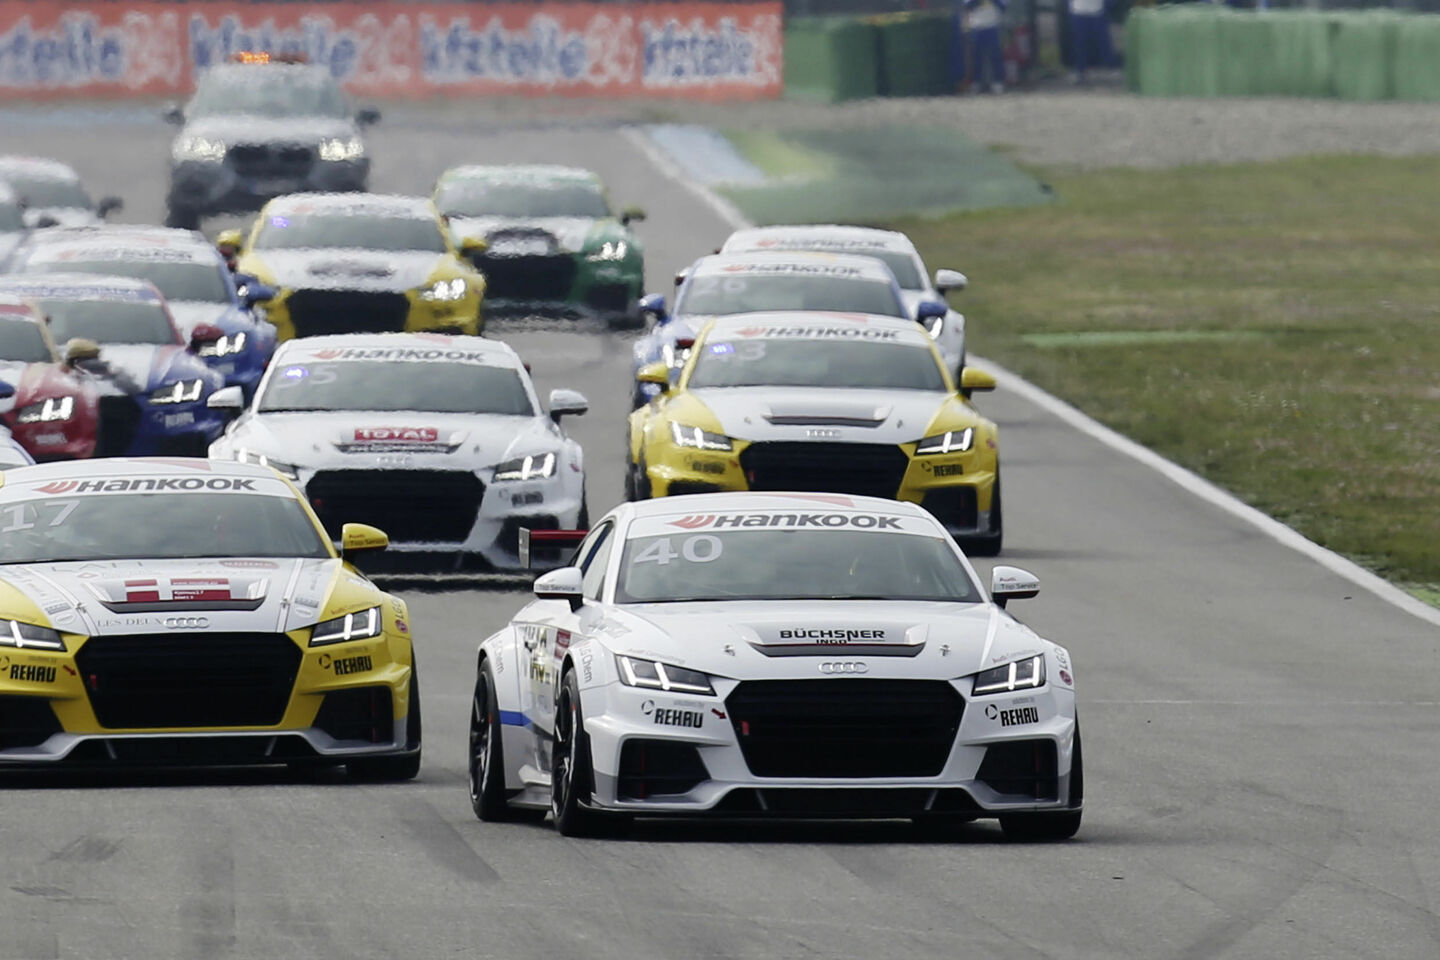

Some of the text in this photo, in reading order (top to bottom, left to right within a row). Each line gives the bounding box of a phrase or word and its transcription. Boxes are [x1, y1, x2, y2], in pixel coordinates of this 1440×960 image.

[0, 500, 81, 533] 17
[633, 535, 723, 565] 40
[779, 627, 885, 642] BÜCHSNER
[10, 664, 57, 683] REHAU
[334, 656, 373, 676] REHAU
[654, 708, 704, 729] REHAU
[999, 706, 1039, 727] REHAU
